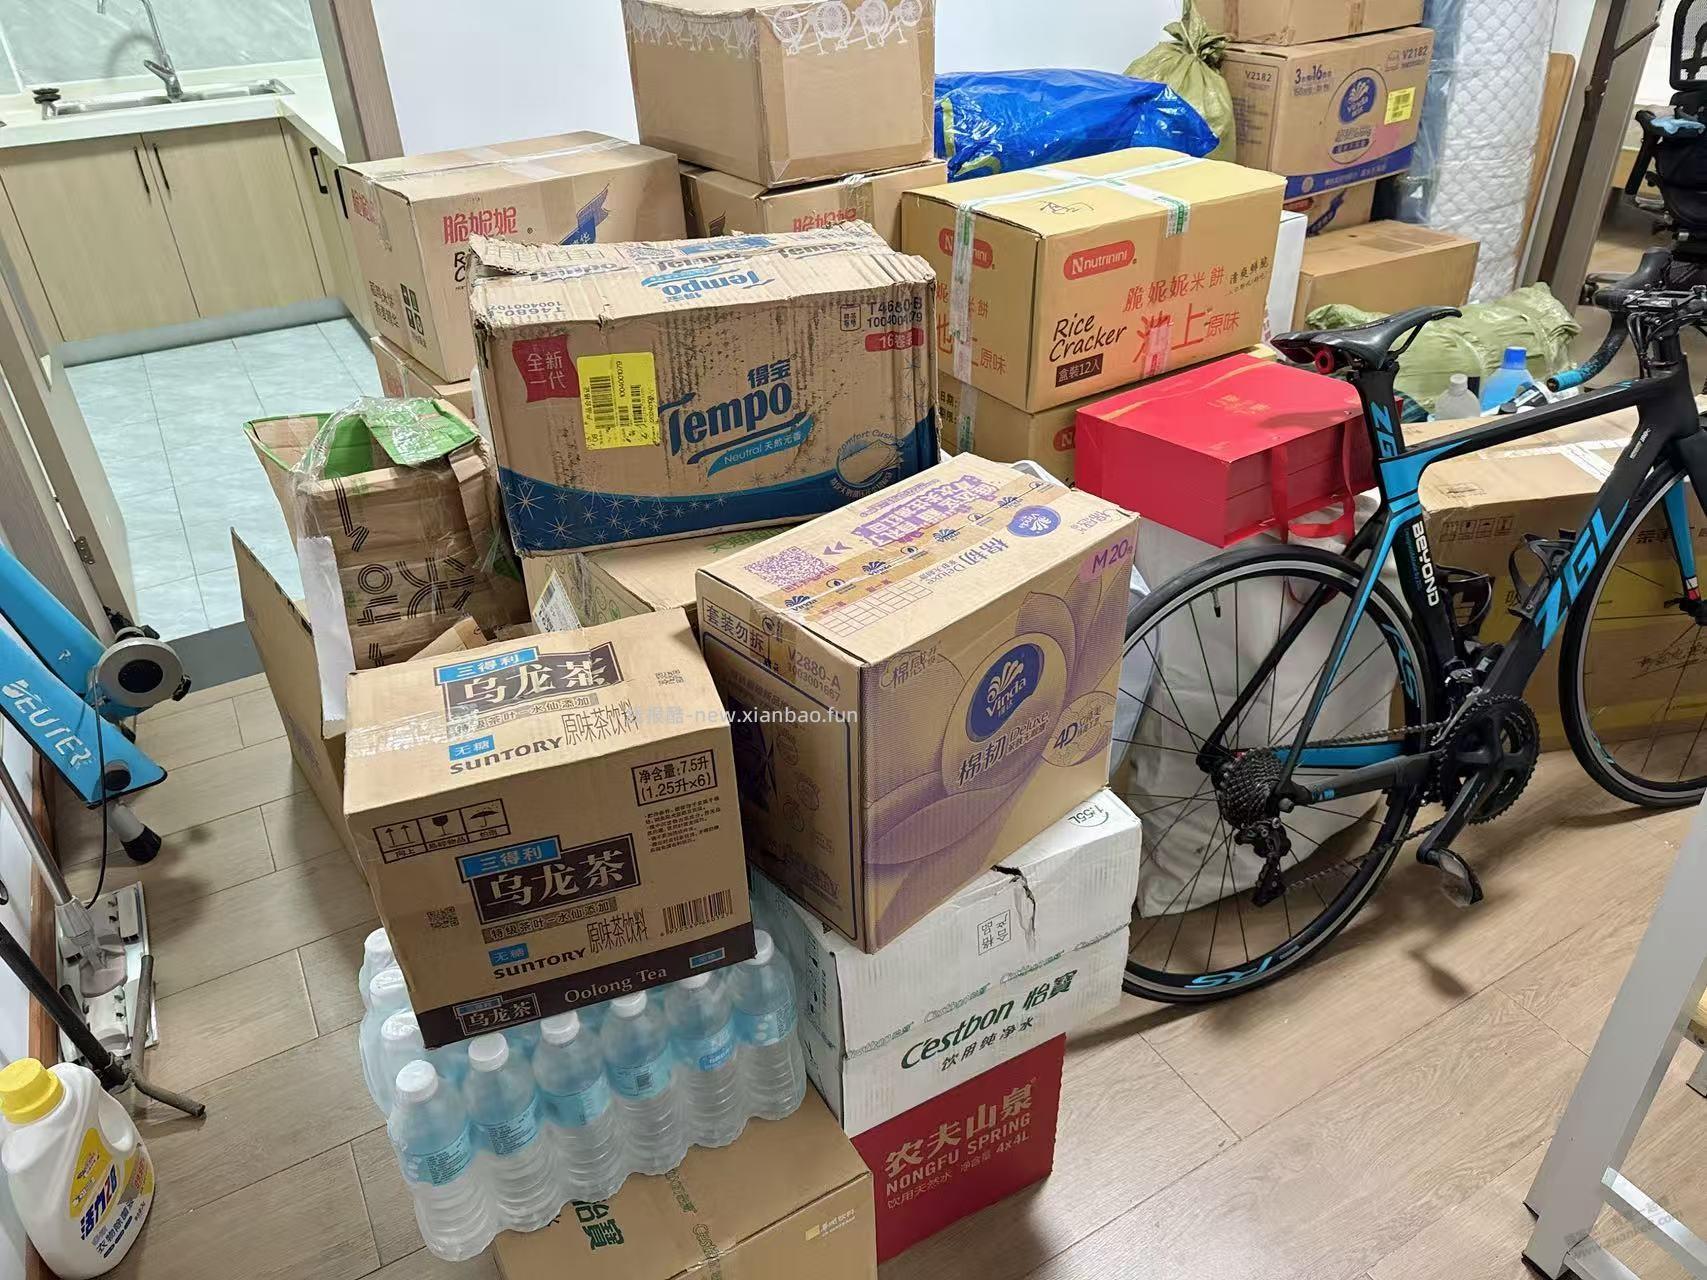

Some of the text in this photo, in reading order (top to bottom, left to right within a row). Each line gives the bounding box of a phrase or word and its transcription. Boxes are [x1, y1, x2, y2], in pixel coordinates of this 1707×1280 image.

[1402, 46, 1428, 59] V2182
[1244, 70, 1273, 83] V2182
[443, 206, 518, 245] 脆妮妮
[661, 270, 767, 297] Tempo
[1049, 326, 1128, 362] Cracker
[1053, 313, 1095, 341] Rice
[527, 350, 564, 372] 全新
[747, 359, 792, 389] 得宝
[529, 371, 568, 391] 一代
[658, 382, 793, 457] Tempo
[723, 443, 763, 466] Neutral
[1411, 521, 1441, 608] BEYOND
[705, 604, 766, 654] 套装勿拆
[456, 652, 522, 679] 三得利
[457, 657, 614, 705] 乌龙茶
[786, 645, 842, 692] V2880-A
[985, 675, 1028, 719] Vinda
[562, 698, 641, 746] 原味茶饮料
[1053, 721, 1078, 750] 4D
[454, 741, 490, 756] 无糖
[959, 734, 1007, 787] 棉韧
[1009, 709, 1050, 740] Deluxe
[1067, 804, 1104, 824] 1.55L
[479, 846, 543, 870] 三得利
[487, 849, 626, 907] 乌龙茶
[587, 908, 649, 955] 原味茶饮料
[493, 946, 526, 964] 无糖
[564, 965, 667, 1004] Oolong Tea
[470, 1001, 532, 1028] 乌龙茶
[941, 1016, 1034, 1072] 饮用纯净水
[884, 1083, 1034, 1179] 农夫山泉
[886, 1112, 1032, 1196] NONGFU SPRING
[887, 1169, 953, 1210] 饮用天然水
[960, 1151, 992, 1173] 净含量
